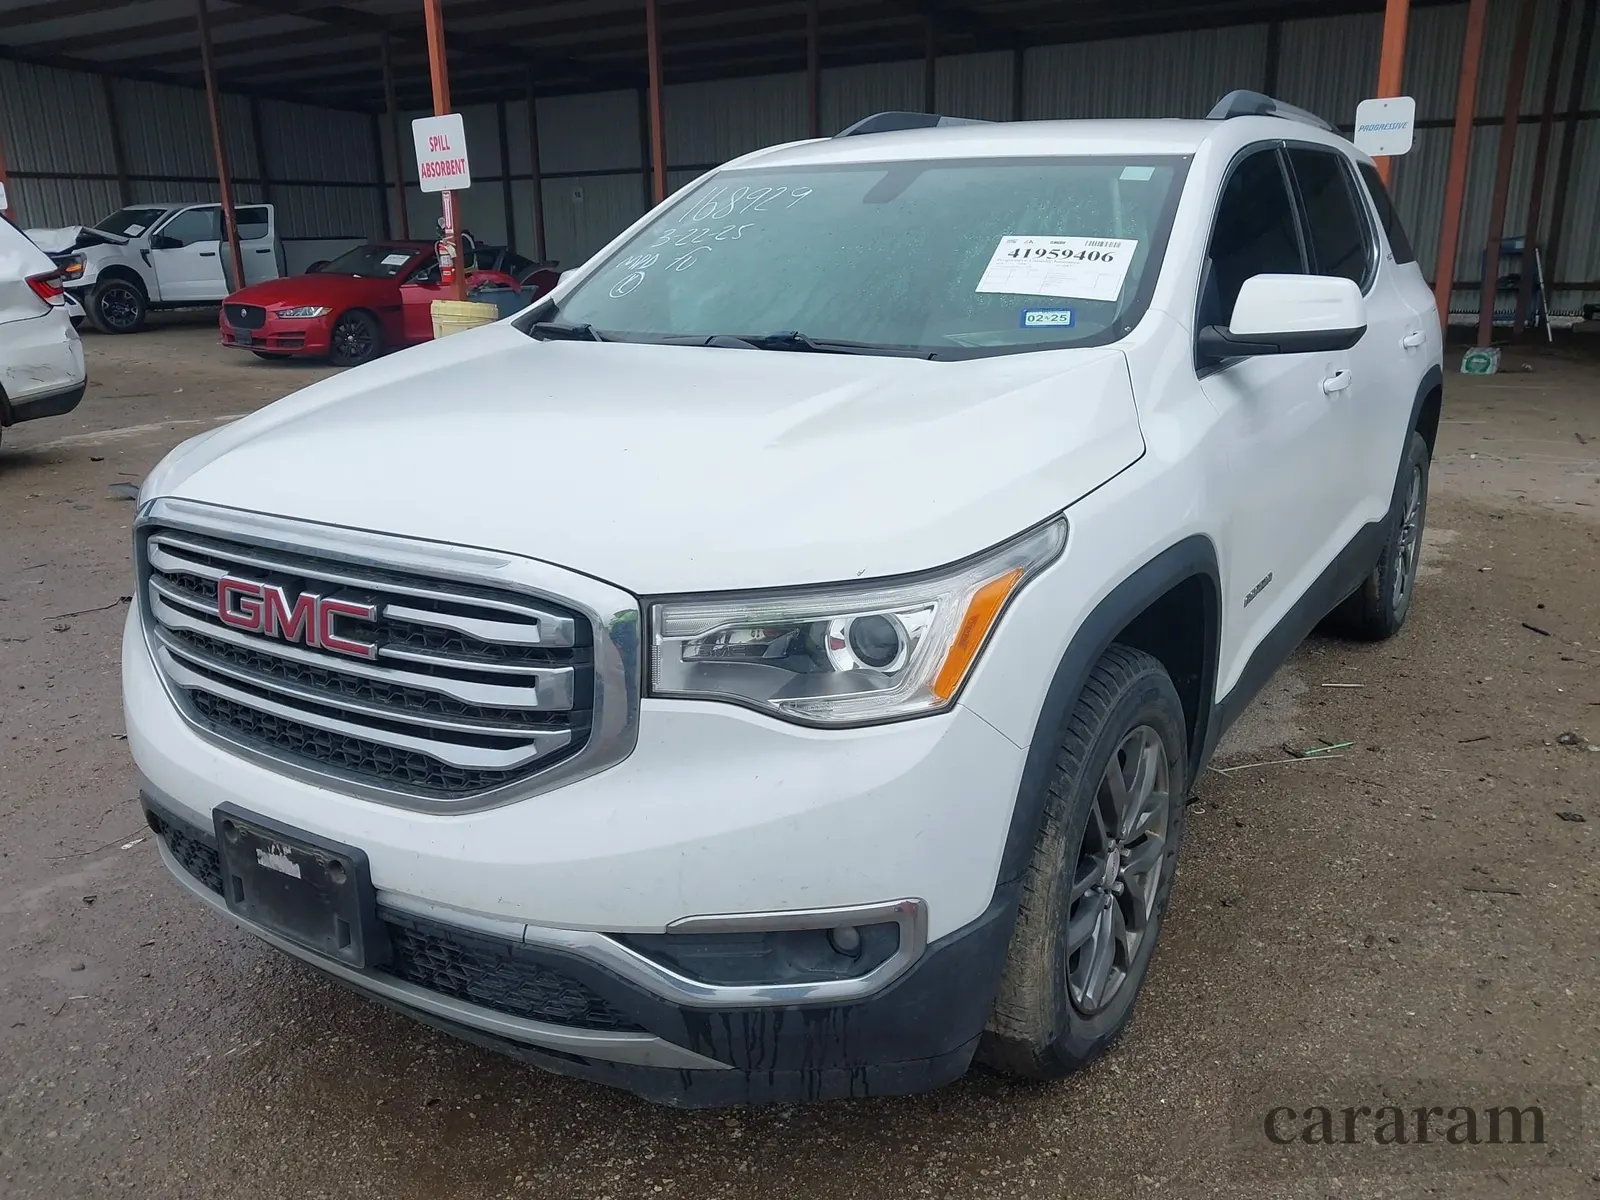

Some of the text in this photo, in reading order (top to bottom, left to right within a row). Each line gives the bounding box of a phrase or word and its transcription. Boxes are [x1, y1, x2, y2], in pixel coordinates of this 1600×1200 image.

[1358, 121, 1408, 132] PROGRESSIVE
[428, 134, 451, 152] SPILL
[421, 158, 466, 179] ABSORBENT
[1007, 247, 1116, 263] 41959406
[1027, 314, 1067, 322] 02 25
[217, 574, 378, 661] GMC
